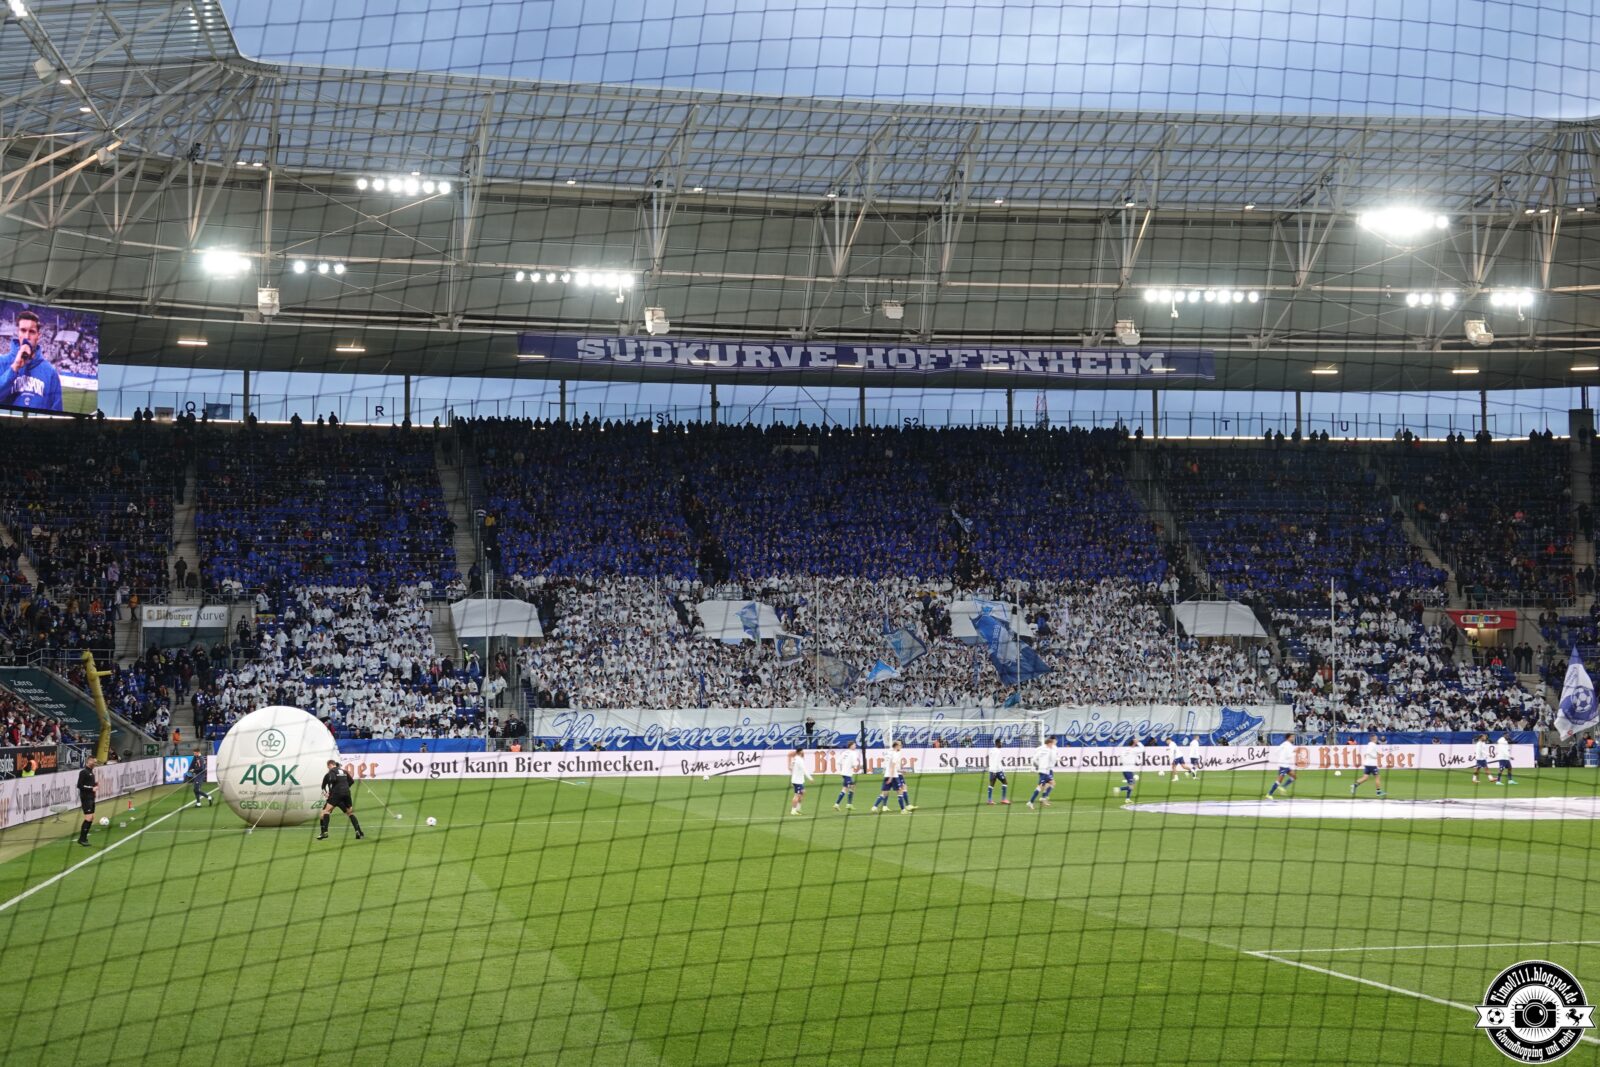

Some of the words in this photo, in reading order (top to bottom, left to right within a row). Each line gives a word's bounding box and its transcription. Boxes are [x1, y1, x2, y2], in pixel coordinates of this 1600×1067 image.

[853, 347, 1166, 375] HOFFENHEIM
[185, 401, 196, 412] Q
[375, 405, 385, 417] R
[656, 412, 671, 424] S1
[903, 417, 919, 428] S2
[1222, 420, 1230, 431] T
[1341, 421, 1349, 432] U
[197, 610, 225, 621] Kurve
[552, 710, 630, 750] Nur
[643, 717, 842, 751] gemeinsam
[681, 758, 712, 775] Bitte
[713, 759, 735, 769] ein
[736, 751, 761, 767] Bit
[939, 753, 959, 767] So
[1225, 752, 1246, 764] ein
[1247, 747, 1270, 761] Bit
[1319, 746, 1415, 769] Bitbrger
[1439, 752, 1465, 767] Bitte
[165, 757, 190, 782] SAP
[402, 757, 424, 775] So
[430, 759, 458, 779] gut
[464, 756, 509, 773] kann
[515, 756, 552, 773] Bier
[557, 755, 660, 773] schmecken.
[239, 764, 300, 786] AOK
